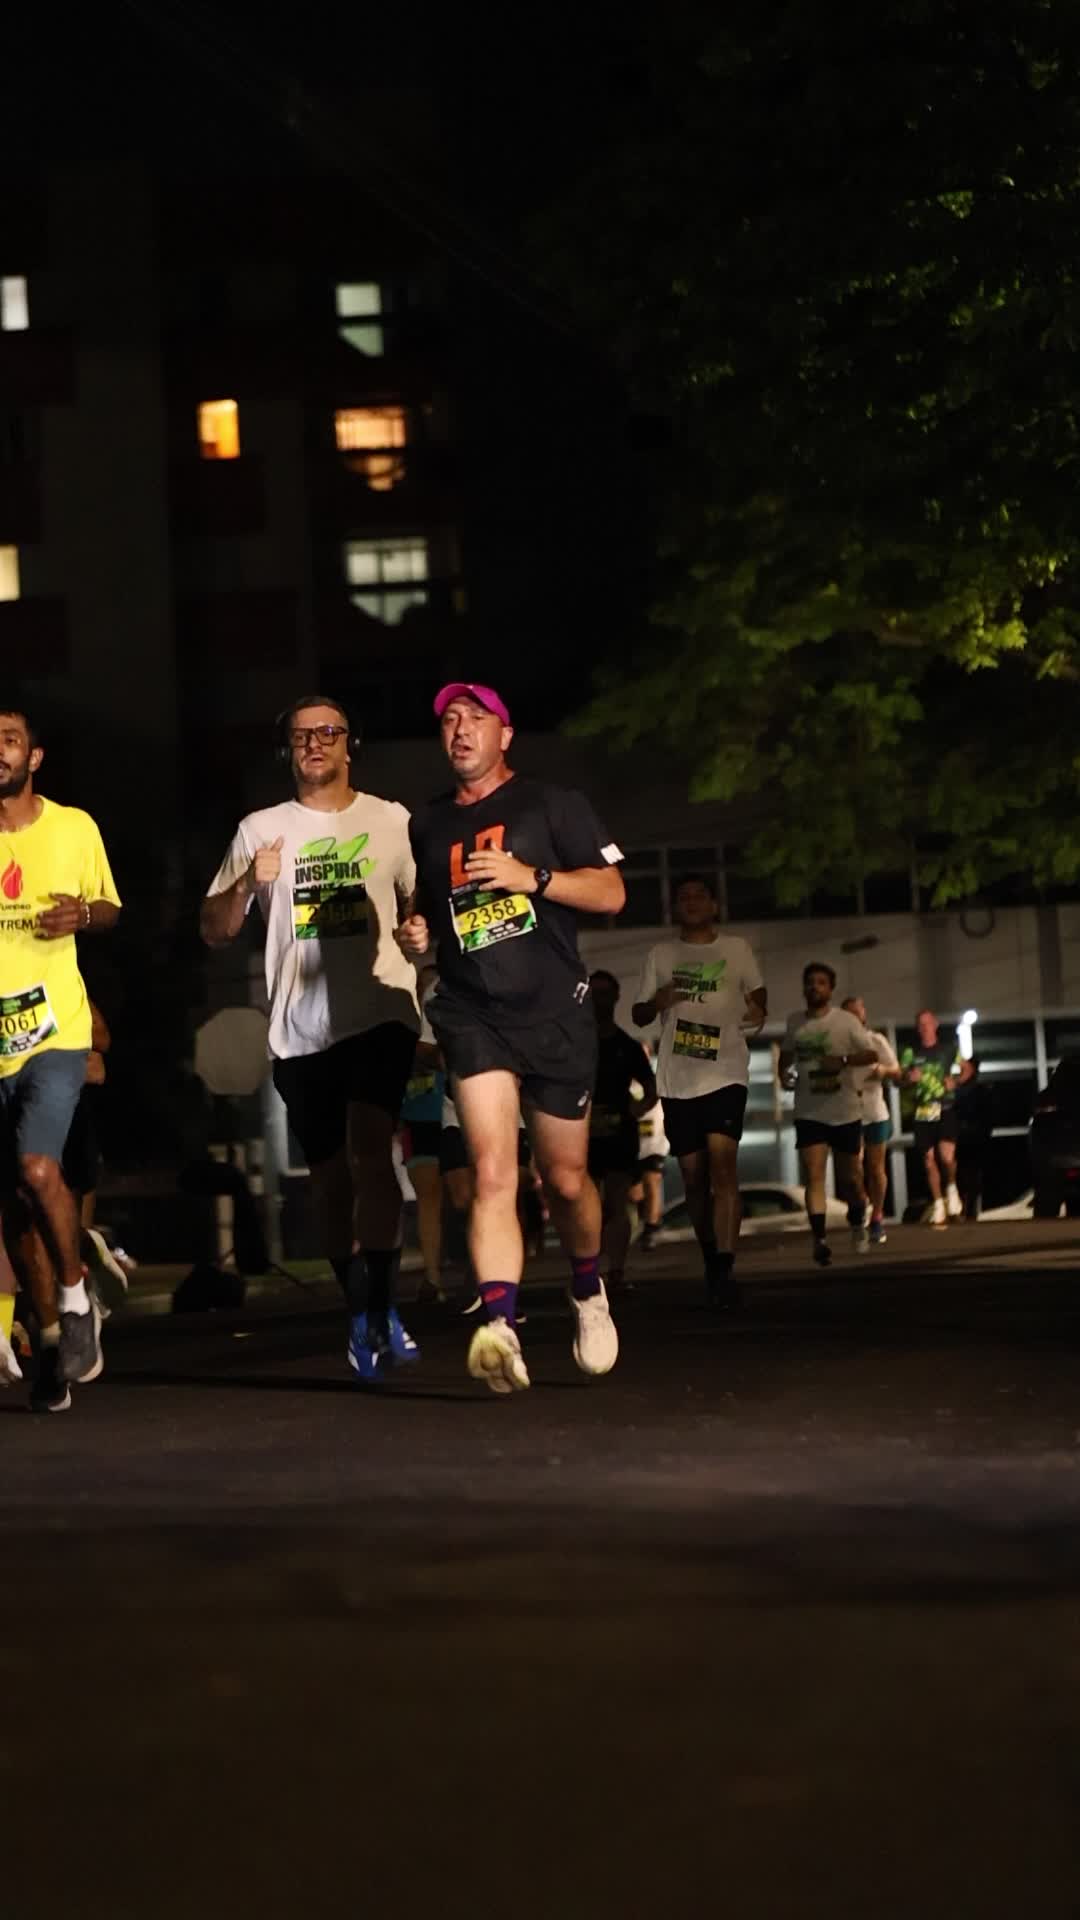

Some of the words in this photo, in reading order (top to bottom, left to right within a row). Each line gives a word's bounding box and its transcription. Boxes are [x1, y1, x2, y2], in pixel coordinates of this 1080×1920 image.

[295, 851, 338, 865] Unimed
[295, 862, 361, 885] INSPIRA
[467, 898, 516, 929] 2358
